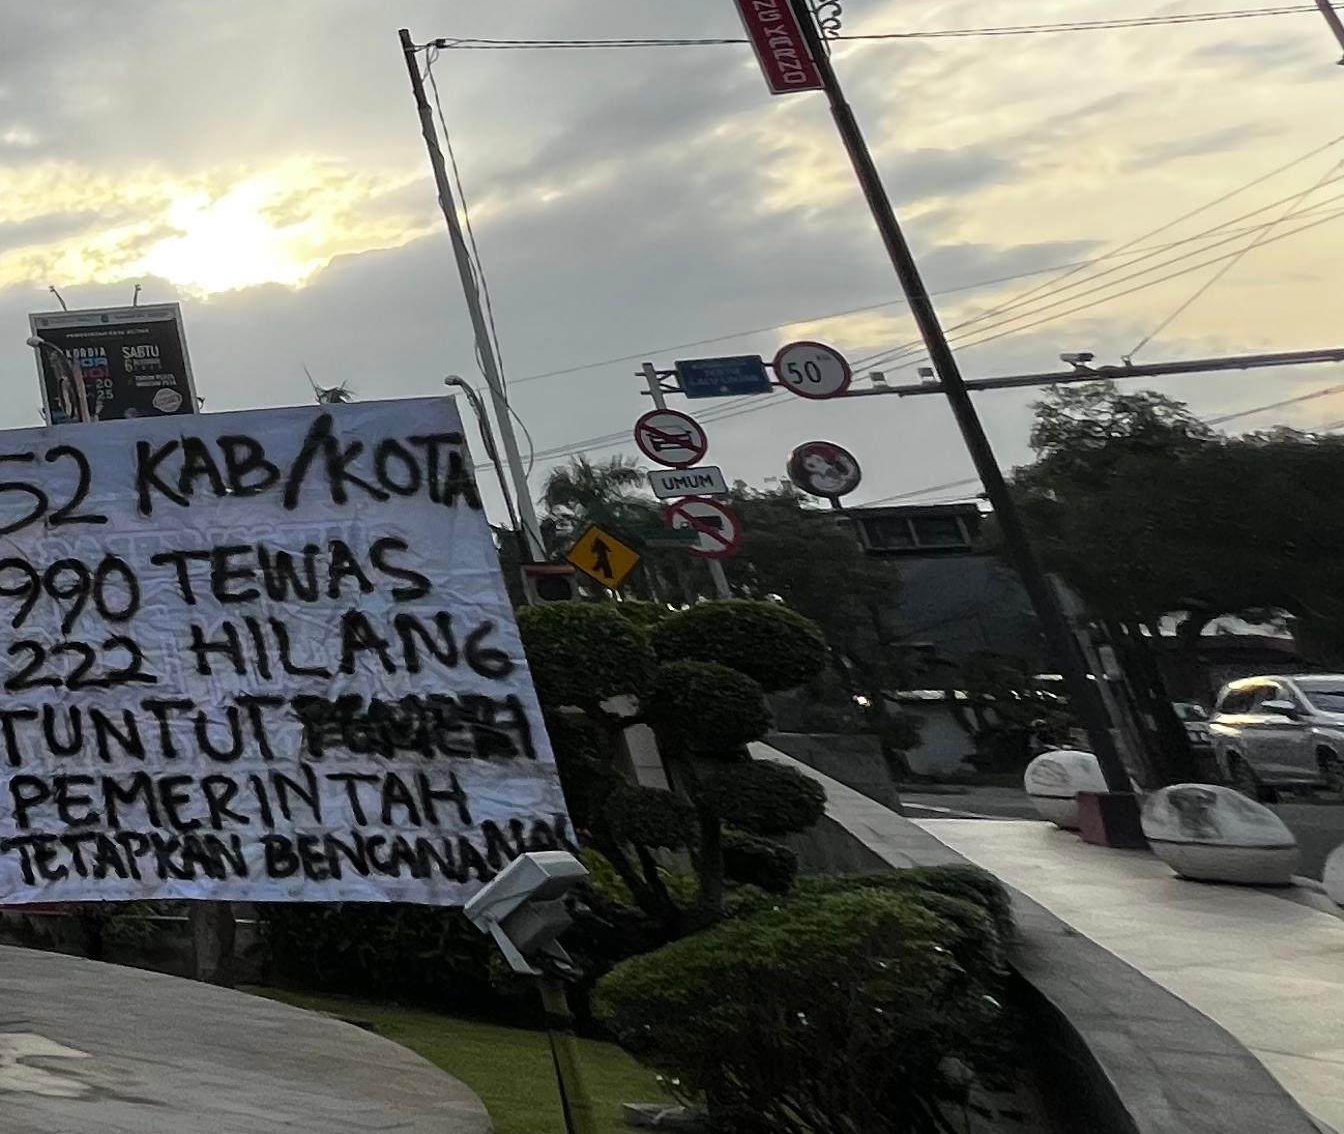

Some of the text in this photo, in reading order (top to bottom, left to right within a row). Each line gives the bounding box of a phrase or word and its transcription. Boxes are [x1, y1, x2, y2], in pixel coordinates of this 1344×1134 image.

[763, 24, 807, 84] KARNO
[121, 345, 160, 359] SABTU
[787, 360, 822, 385] 50
[661, 474, 714, 491] UMUM
[152, 537, 432, 605] TEWAS
[4, 610, 513, 691] 222 HILANG
[10, 768, 472, 830] PEMERINTAH
[0, 831, 242, 885] TETAPKAN
